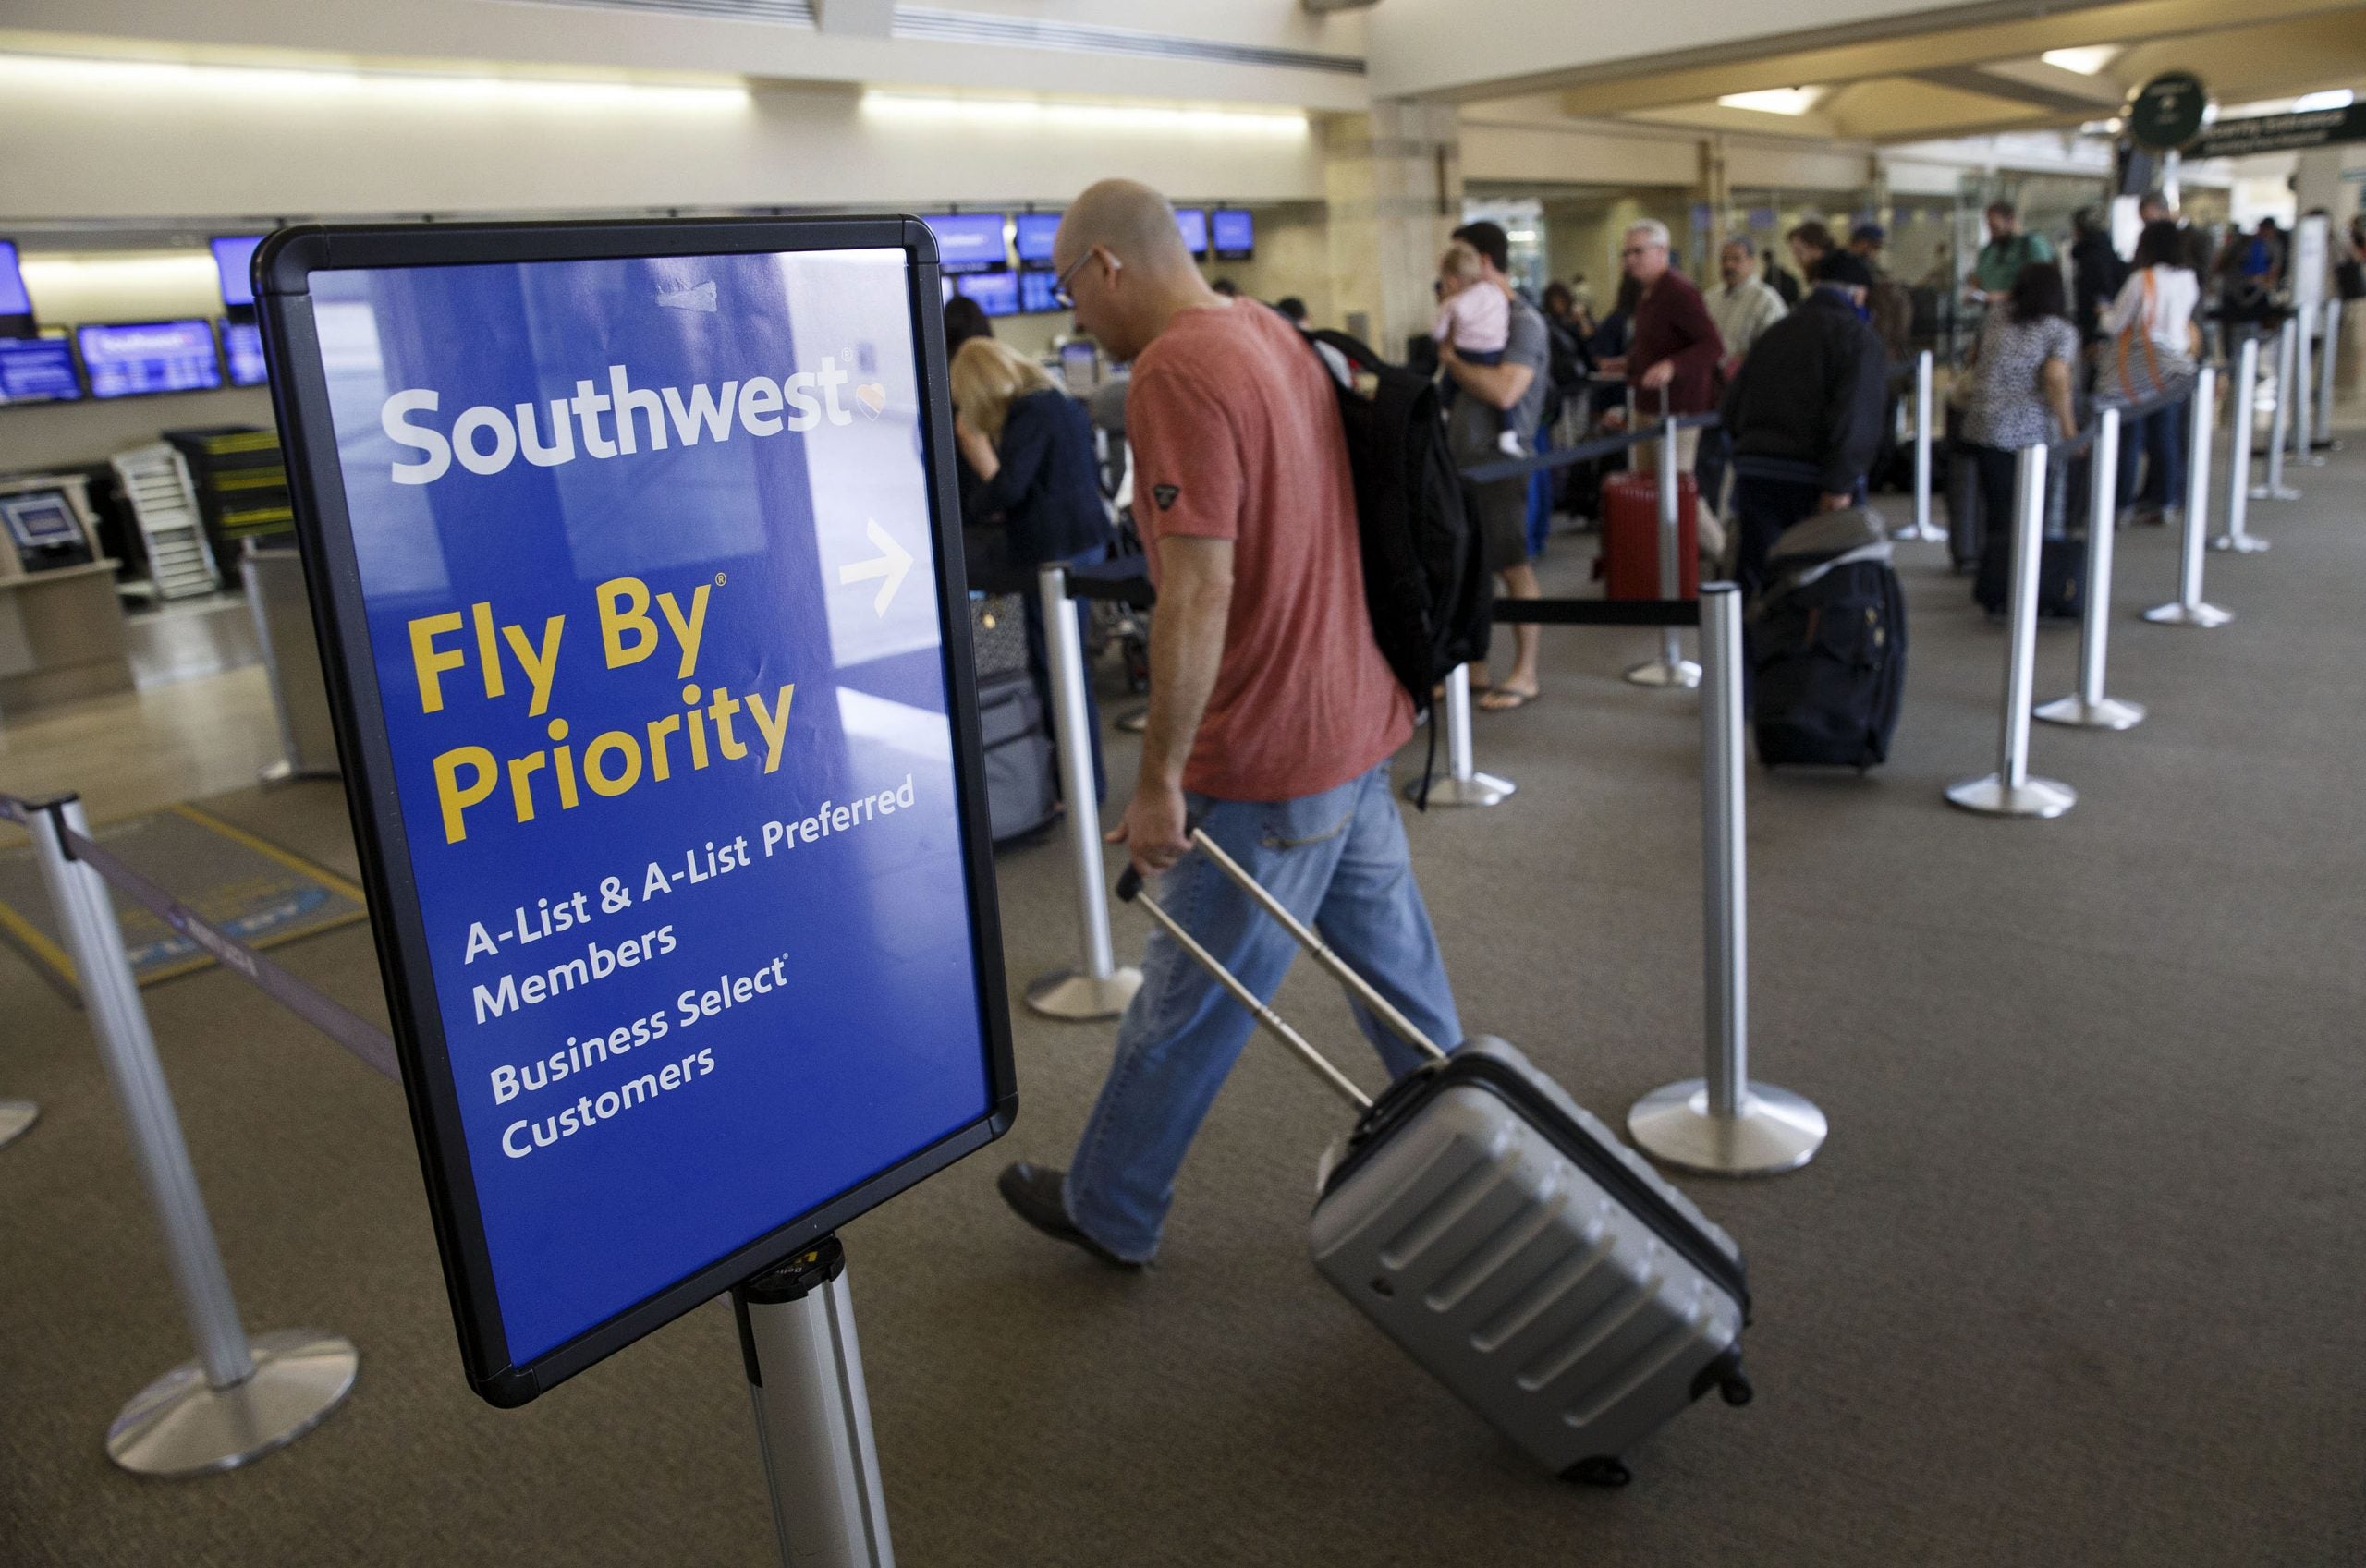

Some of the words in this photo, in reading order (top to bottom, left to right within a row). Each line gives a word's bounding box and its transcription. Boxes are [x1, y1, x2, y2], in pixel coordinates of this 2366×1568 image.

[408, 601, 566, 717] Fly
[433, 683, 796, 845] Priority
[464, 891, 592, 965] A-List
[599, 876, 632, 914] &
[642, 835, 751, 901] A-List
[762, 773, 916, 857] Preferred
[472, 925, 677, 1025] Members
[490, 1010, 669, 1105] Business
[501, 1047, 716, 1159] Customers
